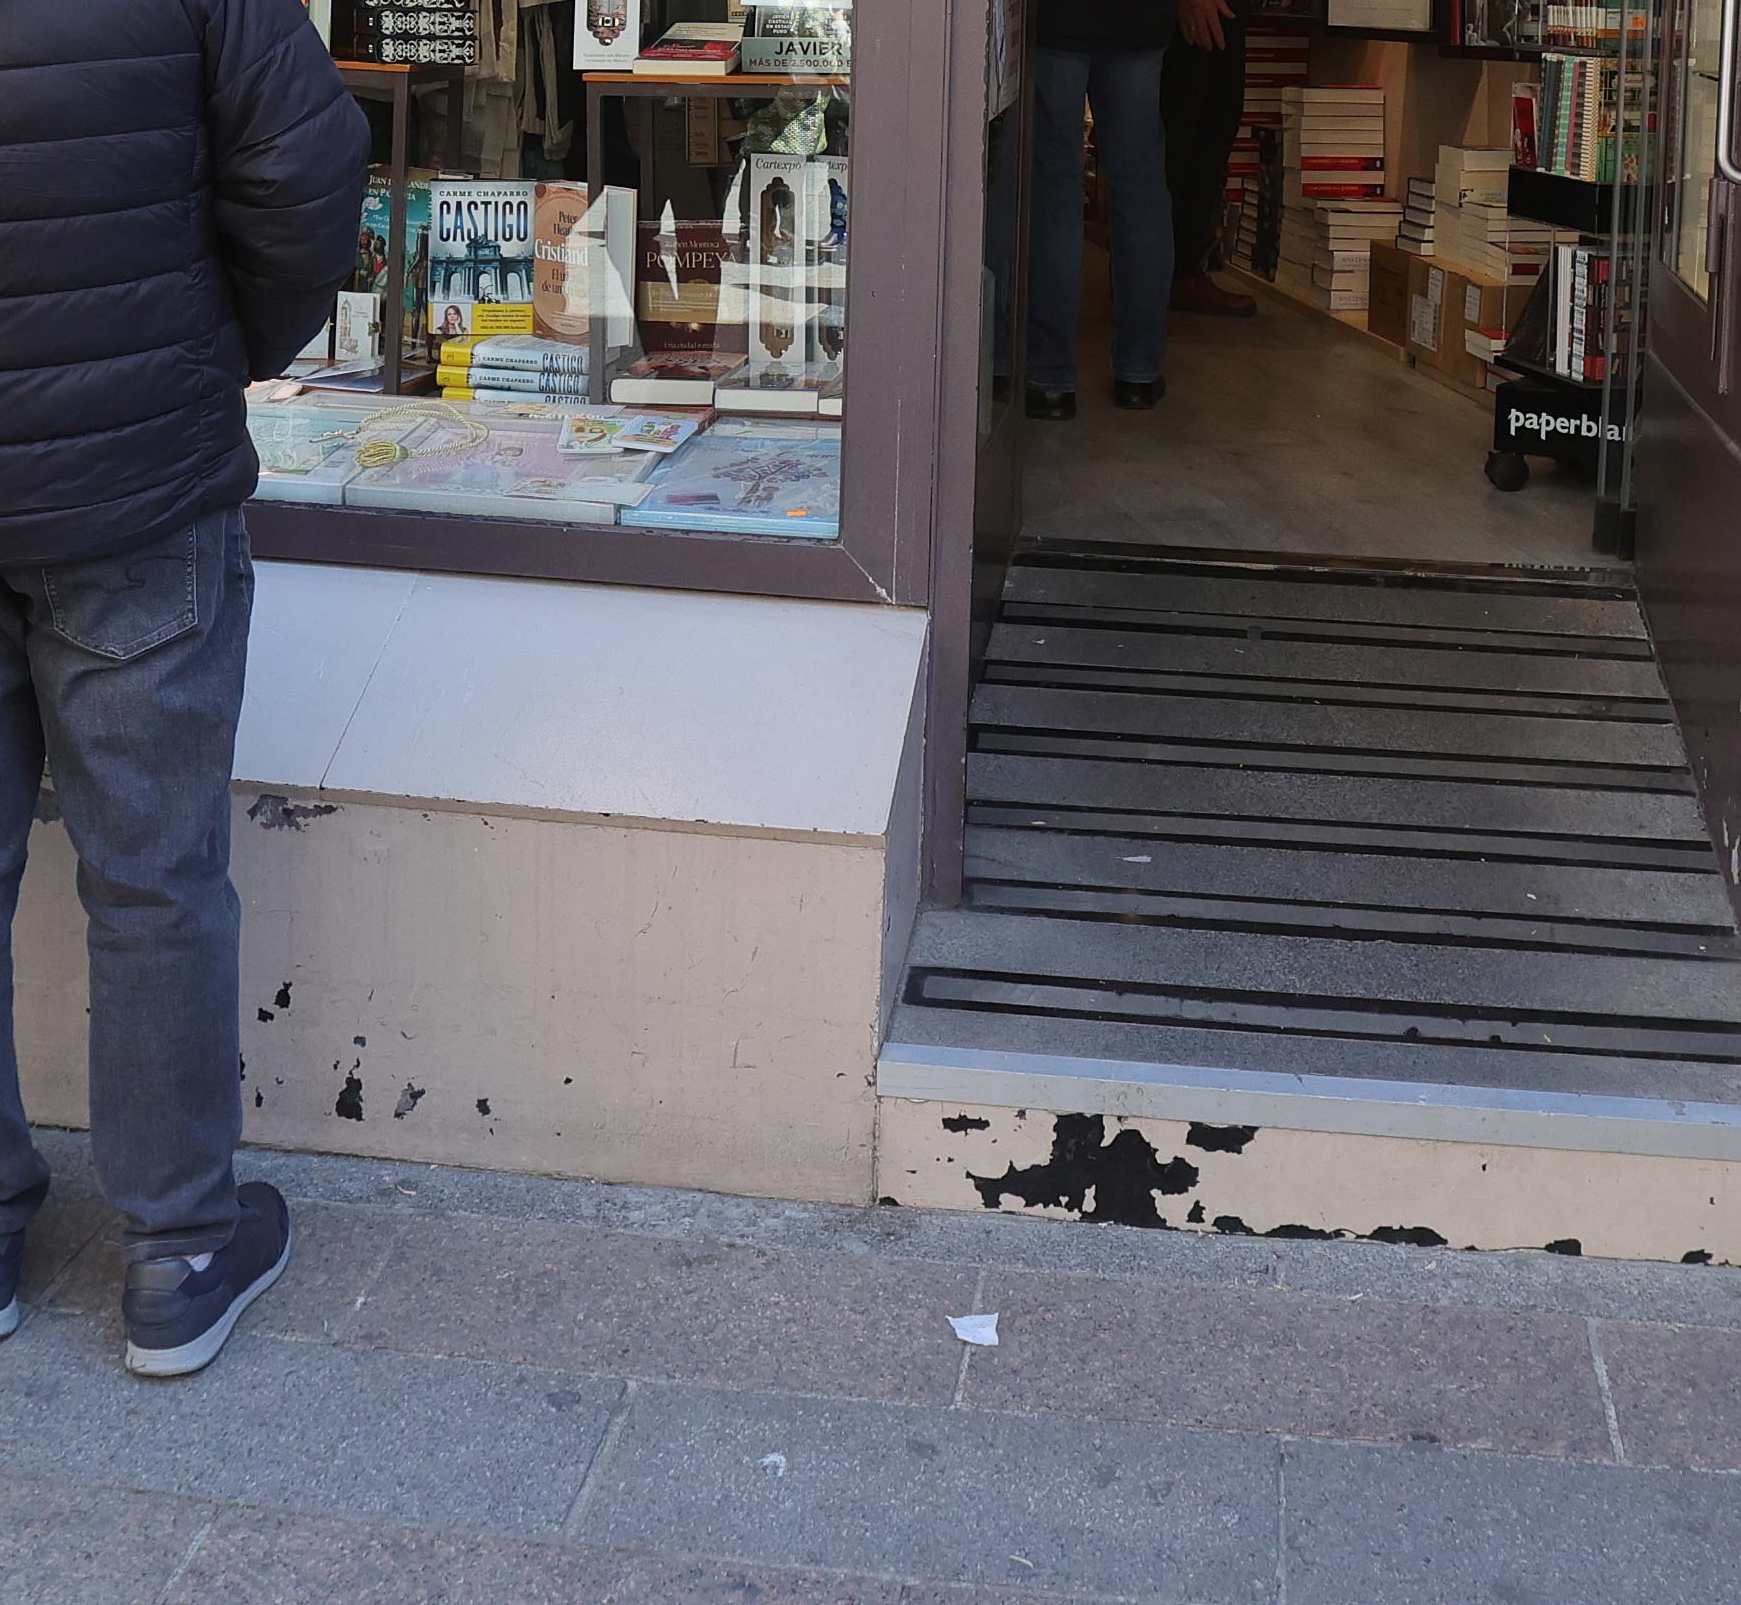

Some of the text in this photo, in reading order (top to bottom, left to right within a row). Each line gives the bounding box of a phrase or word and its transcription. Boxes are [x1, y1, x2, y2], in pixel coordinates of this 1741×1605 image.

[775, 41, 842, 55] JAVIER
[749, 57, 771, 67] MÁS
[774, 59, 787, 67] DE
[755, 158, 801, 171] Cartexpo
[439, 200, 529, 242] CASTIGO
[646, 251, 737, 269] POMPEYA
[506, 357, 538, 365] CHAPARRO
[542, 353, 583, 374] CASTIGO
[538, 373, 579, 394] CASTIGO
